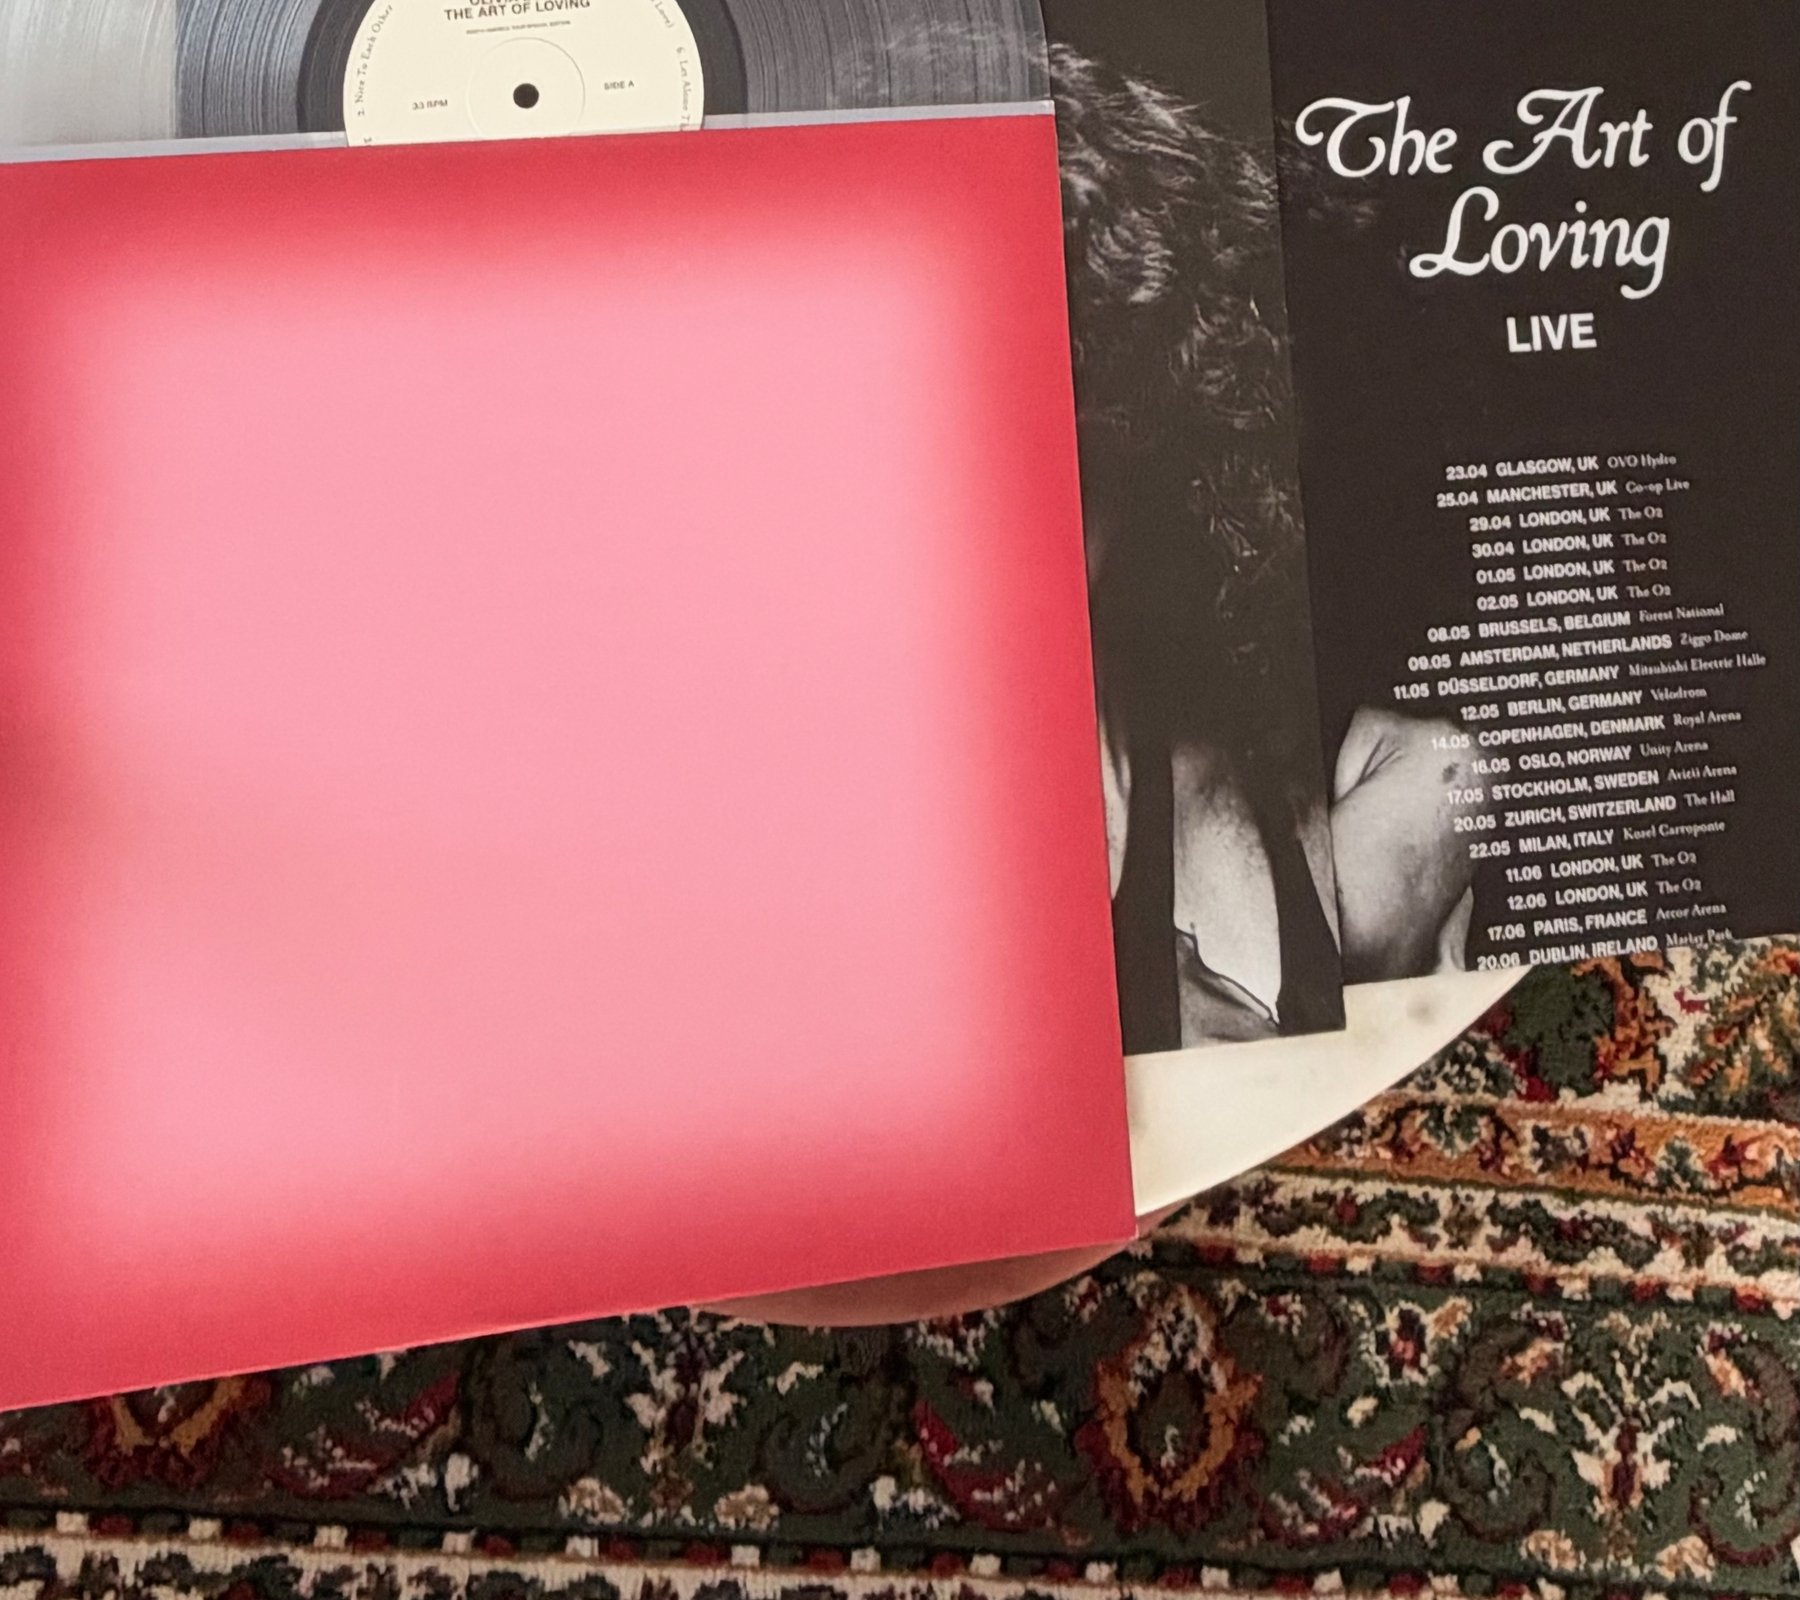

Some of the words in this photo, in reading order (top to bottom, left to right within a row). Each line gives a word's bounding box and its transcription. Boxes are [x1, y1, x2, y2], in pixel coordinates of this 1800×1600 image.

[444, 8, 474, 20] THE
[478, 4, 506, 18] ART
[512, 2, 531, 14] OF
[628, 80, 634, 88] A
[1296, 95, 1458, 178] The
[1482, 86, 1653, 175] Art
[1678, 80, 1752, 192] of
[1409, 186, 1670, 299] Loving
[1506, 312, 1598, 353] LIVE
[1445, 464, 1487, 480] 23.04
[1495, 458, 1575, 476] GLASGOW,
[1576, 455, 1598, 471] UK
[1607, 455, 1638, 467] OVO
[1436, 491, 1478, 507] 25.04
[1486, 482, 1594, 502] MANCHESTER,
[1595, 480, 1617, 495] UK
[1665, 478, 1689, 490] Live
[1469, 515, 1511, 531] 29.04
[1518, 509, 1587, 527] LONDON,
[1588, 506, 1610, 522] UK
[1618, 507, 1641, 519] The
[1643, 506, 1662, 518] O2
[1471, 541, 1514, 558] 30.04
[1522, 535, 1590, 553] LONDON,
[1591, 533, 1613, 548] UK
[1621, 533, 1644, 545] The
[1647, 532, 1666, 543] O2
[1475, 567, 1515, 584] 01.05
[1522, 562, 1591, 580] LONDON,
[1592, 559, 1614, 574] UK
[1622, 559, 1646, 571] The
[1648, 558, 1667, 569] O2
[1476, 594, 1518, 610] 02.05
[1526, 588, 1594, 606] LONDON,
[1595, 585, 1618, 600] UK
[1626, 585, 1649, 597] The
[1651, 584, 1670, 595] O2
[1426, 625, 1470, 642] 08.05
[1478, 617, 1562, 637] BRUSSELS,
[1563, 611, 1630, 630] BELGIUM
[1639, 610, 1673, 621] Forest
[1675, 603, 1724, 618] National
[1407, 653, 1451, 671] 09.05
[1459, 644, 1560, 665] AMSTERDAM,
[1561, 634, 1672, 656] NETHERLANDS
[1713, 630, 1747, 641] Dome
[1393, 682, 1429, 699] 11.05
[1437, 672, 1542, 695] DÜSSELDORF,
[1544, 665, 1619, 685] GERMANY
[1690, 658, 1732, 670] Electric
[1736, 653, 1765, 666] Halle
[1460, 703, 1499, 720] 12.05
[1506, 697, 1566, 716] BERLIN,
[1567, 690, 1642, 710] GERMANY
[1478, 723, 1588, 746] COPENHAGEN,
[1589, 715, 1665, 735] DENMARK
[1672, 711, 1704, 727] Royal
[1707, 711, 1741, 722] Arena
[1518, 752, 1565, 769] OSLO,
[1566, 745, 1631, 764] NORWAY
[1674, 741, 1708, 752] Arena
[1448, 788, 1484, 804] 17.05
[1491, 777, 1592, 799] STOCKHOLM,
[1593, 770, 1659, 789] SWEDEN
[1702, 765, 1736, 776] Arena
[1453, 814, 1496, 831] 20.05
[1504, 807, 1566, 826] ZURICH,
[1567, 795, 1676, 819] SWITZERLAND
[1684, 793, 1707, 806] The
[1710, 789, 1735, 803] Hall
[1468, 840, 1510, 858] 22.05
[1518, 834, 1571, 852] MILAN,
[1572, 829, 1613, 847] ITALY
[1505, 865, 1542, 882] 11.06
[1550, 857, 1619, 877] LONDON,
[1620, 854, 1643, 869] UK
[1651, 854, 1674, 866] The
[1677, 851, 1696, 864] O2
[1506, 892, 1547, 910] 12.06
[1554, 884, 1624, 904] LONDON,
[1625, 880, 1648, 896] UK
[1656, 880, 1679, 893] The
[1681, 878, 1701, 890] O2
[1487, 923, 1525, 940] 17.06
[1533, 917, 1583, 935] PARIS,
[1584, 908, 1647, 929] FRANCE
[1656, 908, 1688, 919] Accor
[1691, 904, 1726, 915] Arena
[1591, 936, 1658, 958] IRELAND
[1707, 928, 1733, 944] Park
